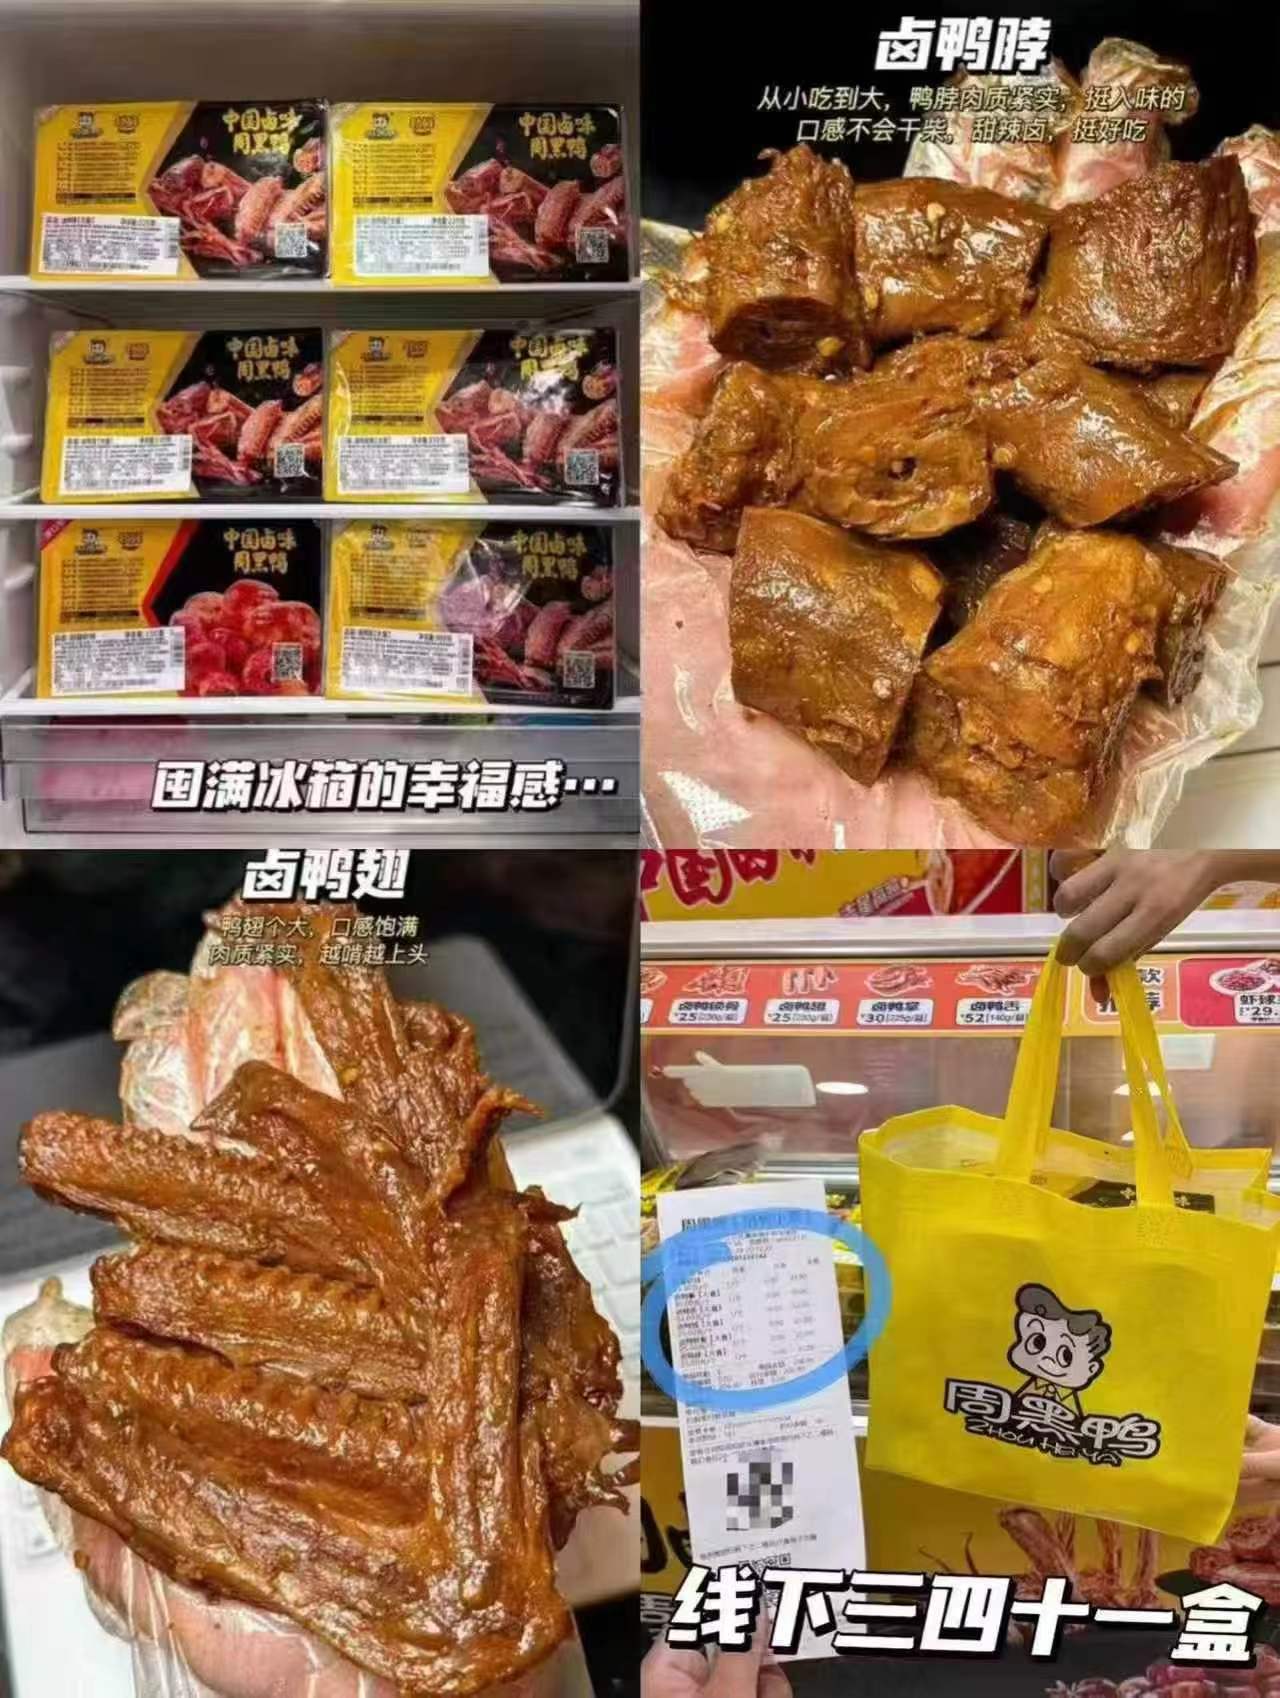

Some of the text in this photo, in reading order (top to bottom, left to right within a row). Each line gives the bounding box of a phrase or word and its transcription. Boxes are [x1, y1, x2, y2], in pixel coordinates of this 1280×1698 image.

[223, 108, 303, 132] 中国卤味
[518, 112, 596, 137] 中国卤味
[529, 136, 587, 160] 周黑鸭
[226, 336, 299, 360] 中国卤味
[223, 527, 298, 551] 中国卤味
[233, 551, 288, 574] 周黑鸭
[1240, 994, 1280, 1004] 虾球
[945, 1379, 1162, 1459] 周黑鸭
